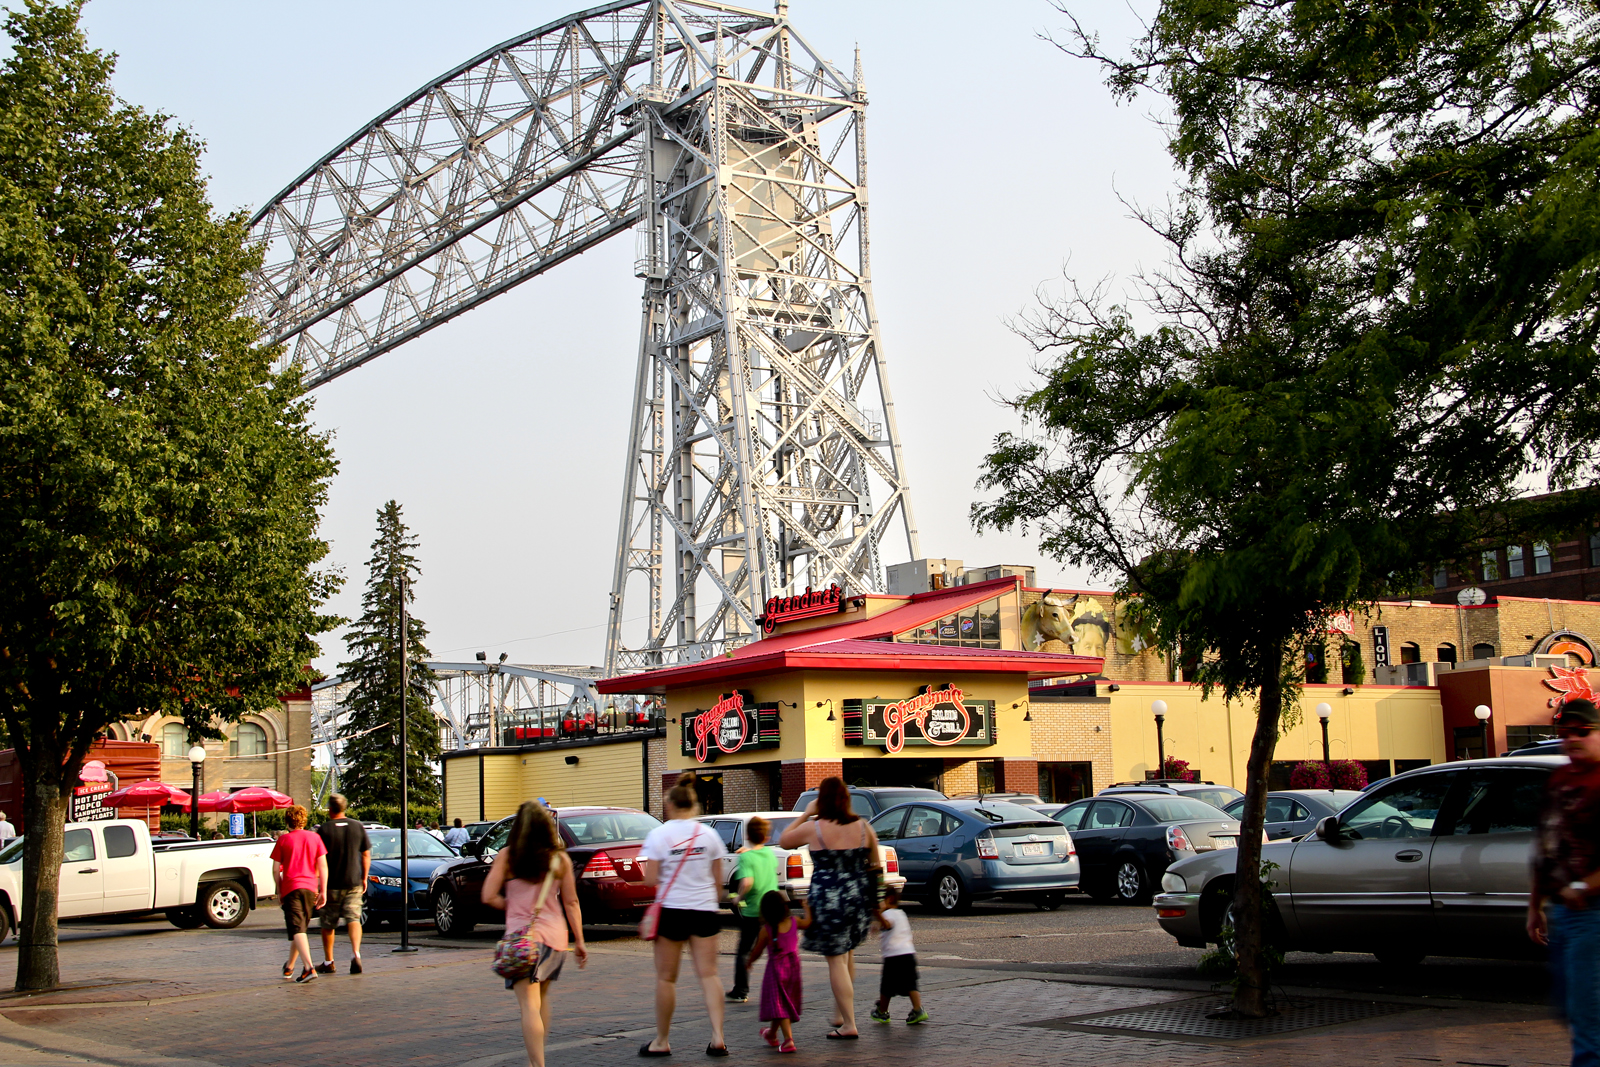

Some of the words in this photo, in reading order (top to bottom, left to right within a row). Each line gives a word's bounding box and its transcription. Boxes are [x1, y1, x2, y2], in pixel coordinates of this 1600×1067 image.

[764, 582, 841, 634] Grandma's
[1374, 629, 1386, 667] LIQUO
[883, 682, 971, 754] Grandma's
[932, 710, 958, 721] SALOON
[694, 689, 748, 763] Grandma's
[927, 721, 942, 738] &
[941, 722, 963, 734] GRILL
[91, 784, 109, 792] CREAM
[75, 796, 91, 805] HOT
[75, 801, 102, 812] POPCO
[74, 807, 114, 818] SANDWICHES
